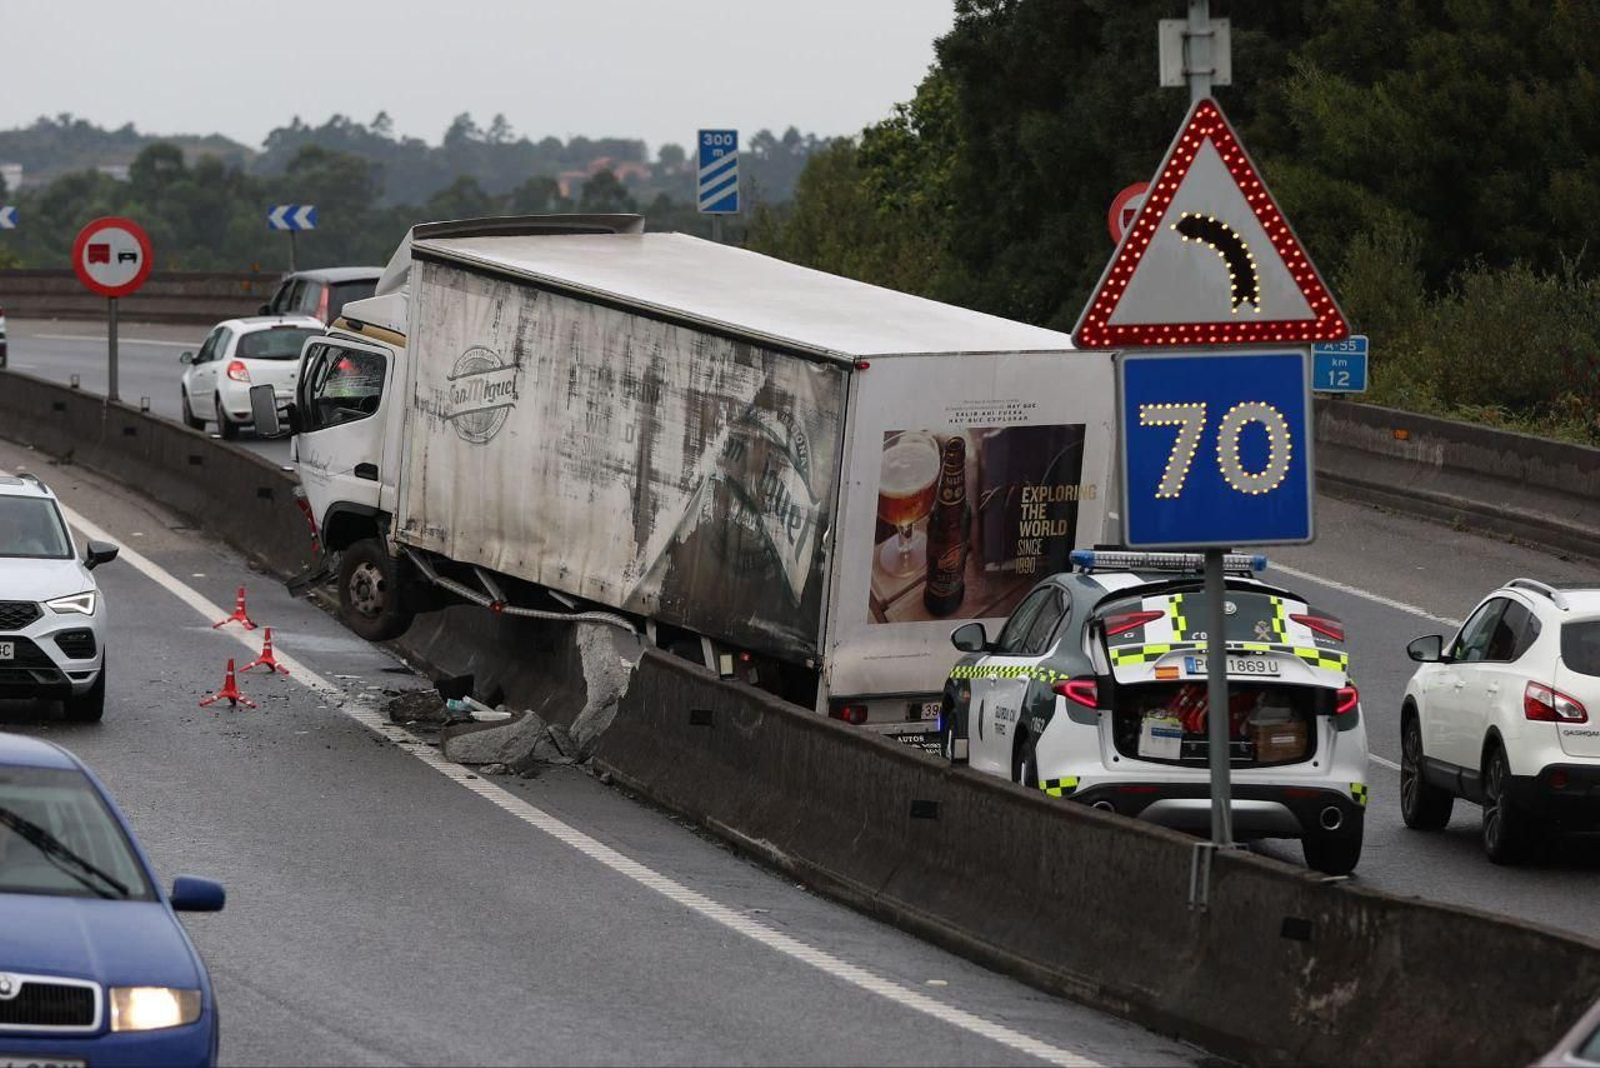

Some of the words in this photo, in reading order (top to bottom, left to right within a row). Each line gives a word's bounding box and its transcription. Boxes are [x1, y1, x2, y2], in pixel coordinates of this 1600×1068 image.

[703, 133, 732, 146] 300
[712, 149, 725, 158] m
[1331, 357, 1348, 367] km
[1328, 370, 1351, 386] 12
[1139, 401, 1293, 498] 70
[1021, 484, 1097, 503] EXPLORING
[1020, 503, 1047, 520] THE
[1019, 519, 1068, 537] WORLD
[1017, 539, 1043, 556] SINCE
[1015, 557, 1037, 574] 1890
[1229, 659, 1264, 673] 1869
[1268, 660, 1279, 673] U
